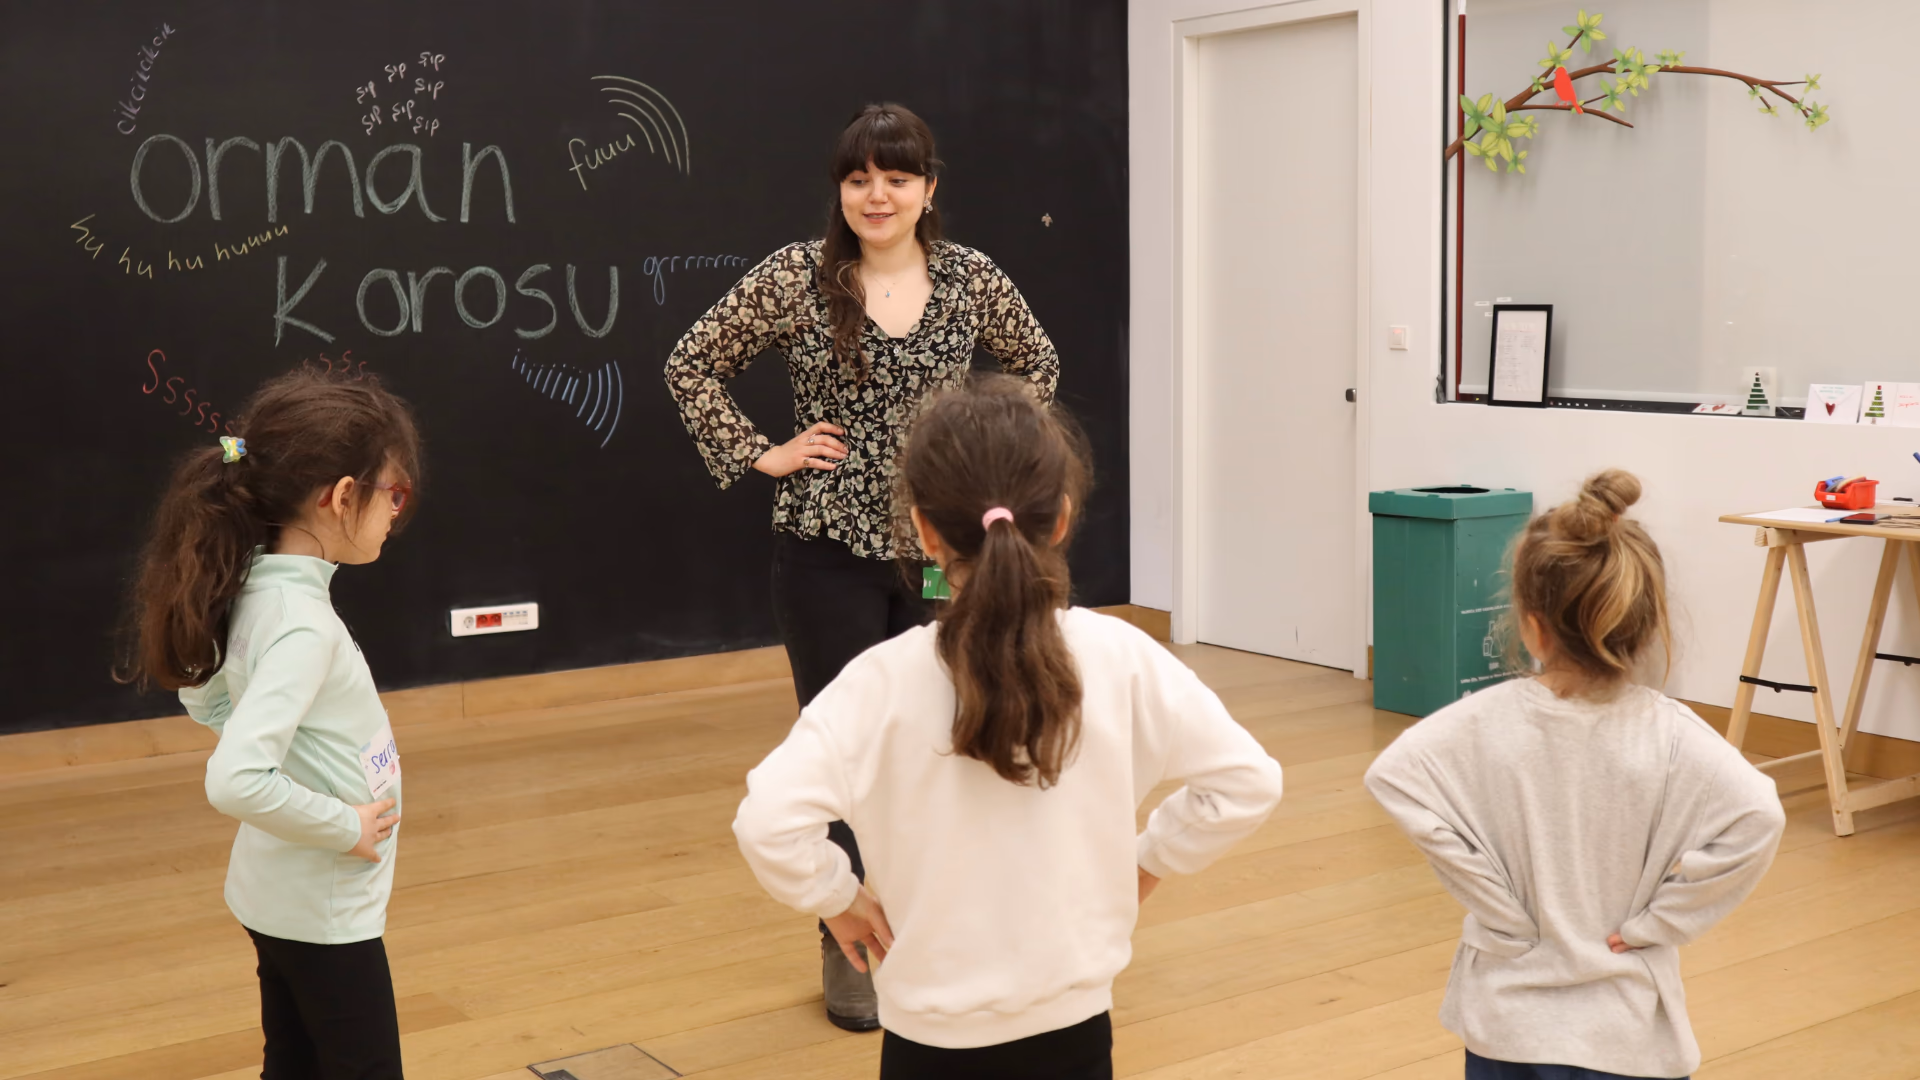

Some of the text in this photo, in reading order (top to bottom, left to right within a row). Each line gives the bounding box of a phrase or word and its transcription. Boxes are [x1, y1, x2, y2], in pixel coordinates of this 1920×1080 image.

[130, 133, 516, 224] orman
[569, 133, 636, 191] fuuu
[118, 246, 152, 280] hu
[168, 250, 203, 271] hu
